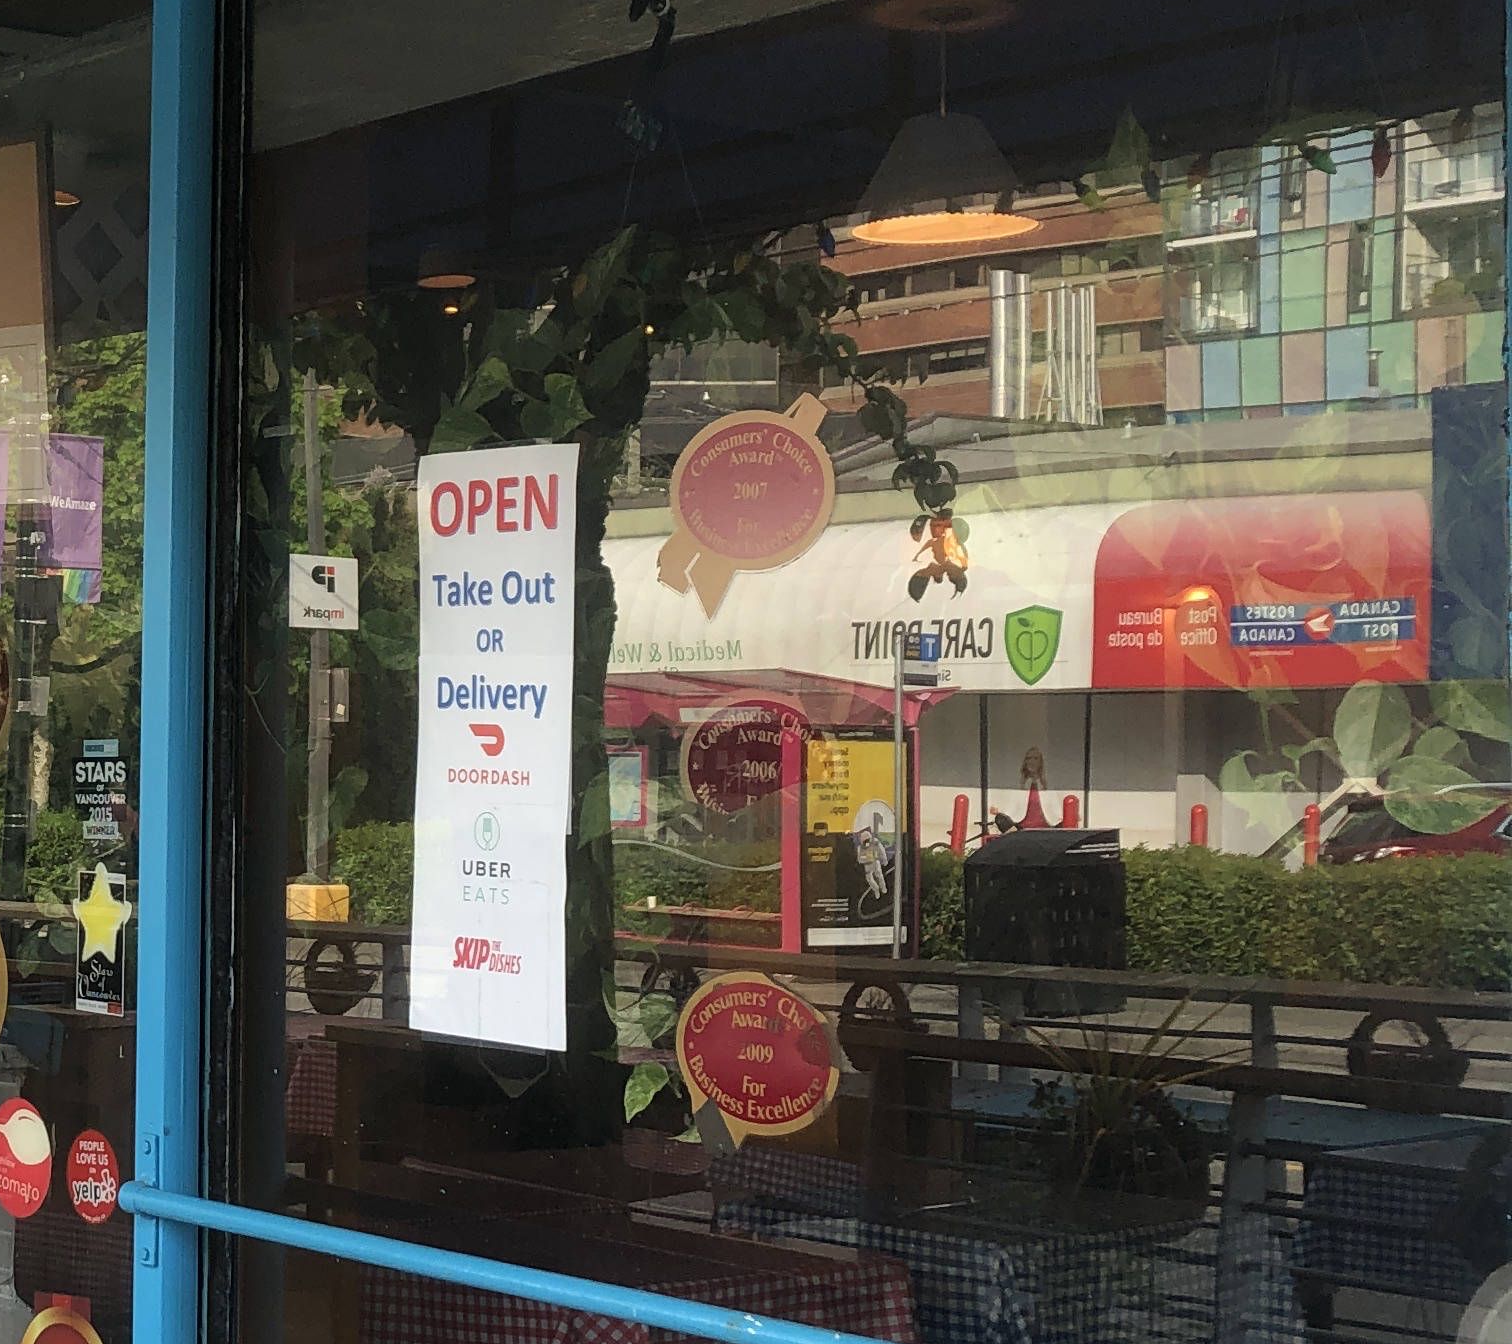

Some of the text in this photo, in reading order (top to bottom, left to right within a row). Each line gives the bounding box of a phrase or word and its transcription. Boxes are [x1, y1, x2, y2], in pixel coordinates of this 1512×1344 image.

[773, 432, 814, 476] Choice
[733, 482, 769, 500] 2007
[430, 474, 559, 538] OPEN
[689, 508, 738, 549] Busine
[432, 570, 555, 607] Take Out
[476, 629, 504, 652] OR
[437, 674, 548, 719] Delivery
[736, 727, 782, 746] Award
[75, 761, 126, 783] STARS
[448, 768, 530, 786] DOORDASH
[742, 760, 778, 779] 2006
[75, 793, 127, 805] VANCOUVER
[88, 807, 113, 822] 2015
[462, 860, 511, 879] UBER
[463, 886, 509, 905] EATS
[452, 936, 489, 970] SKIP
[488, 953, 522, 975] DISHES
[778, 997, 808, 1031] Cho
[689, 1054, 823, 1120] Business Excellence
[742, 1075, 766, 1097] For
[79, 1140, 105, 1152] PEOPLE
[76, 1153, 109, 1166] LOVE US
[72, 1177, 102, 1207] yelp
